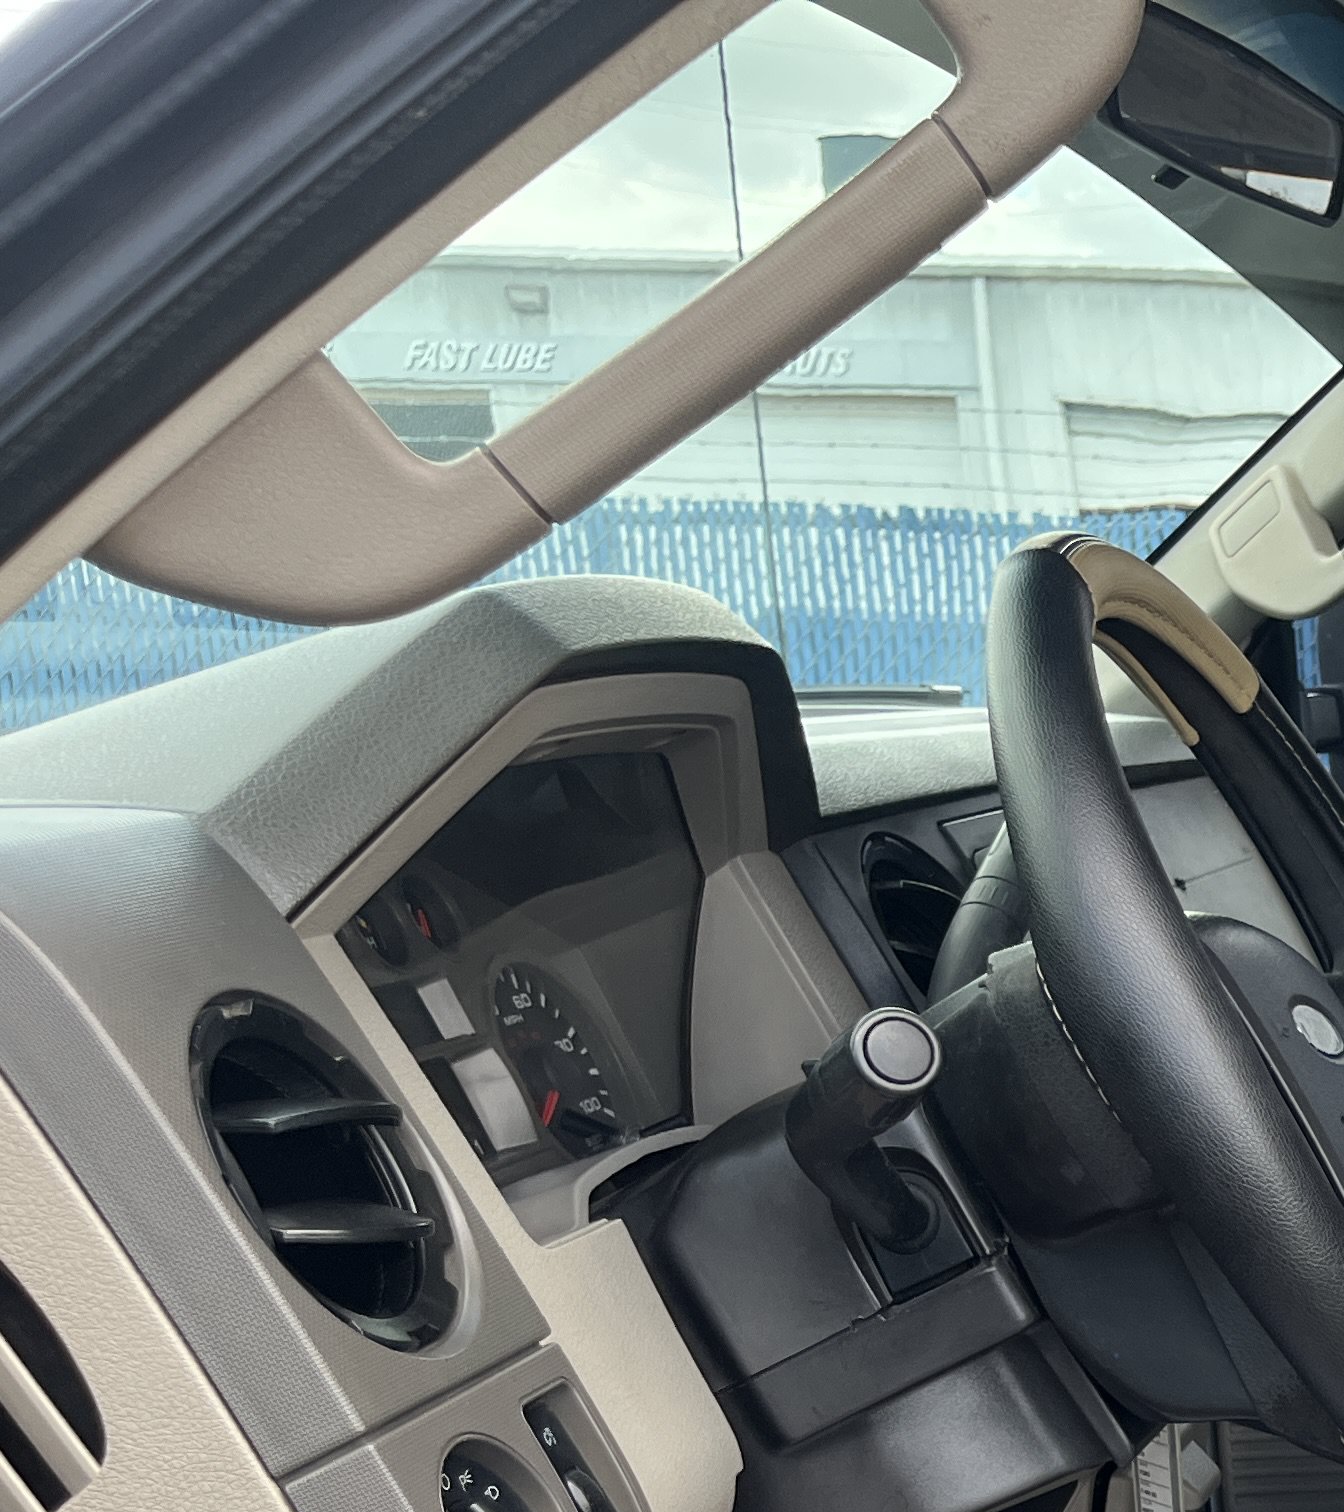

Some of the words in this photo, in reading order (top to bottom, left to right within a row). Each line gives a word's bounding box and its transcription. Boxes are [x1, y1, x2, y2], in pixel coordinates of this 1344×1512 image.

[402, 338, 480, 372] FAST
[480, 342, 559, 373] LUBE
[579, 1096, 602, 1115] 100
